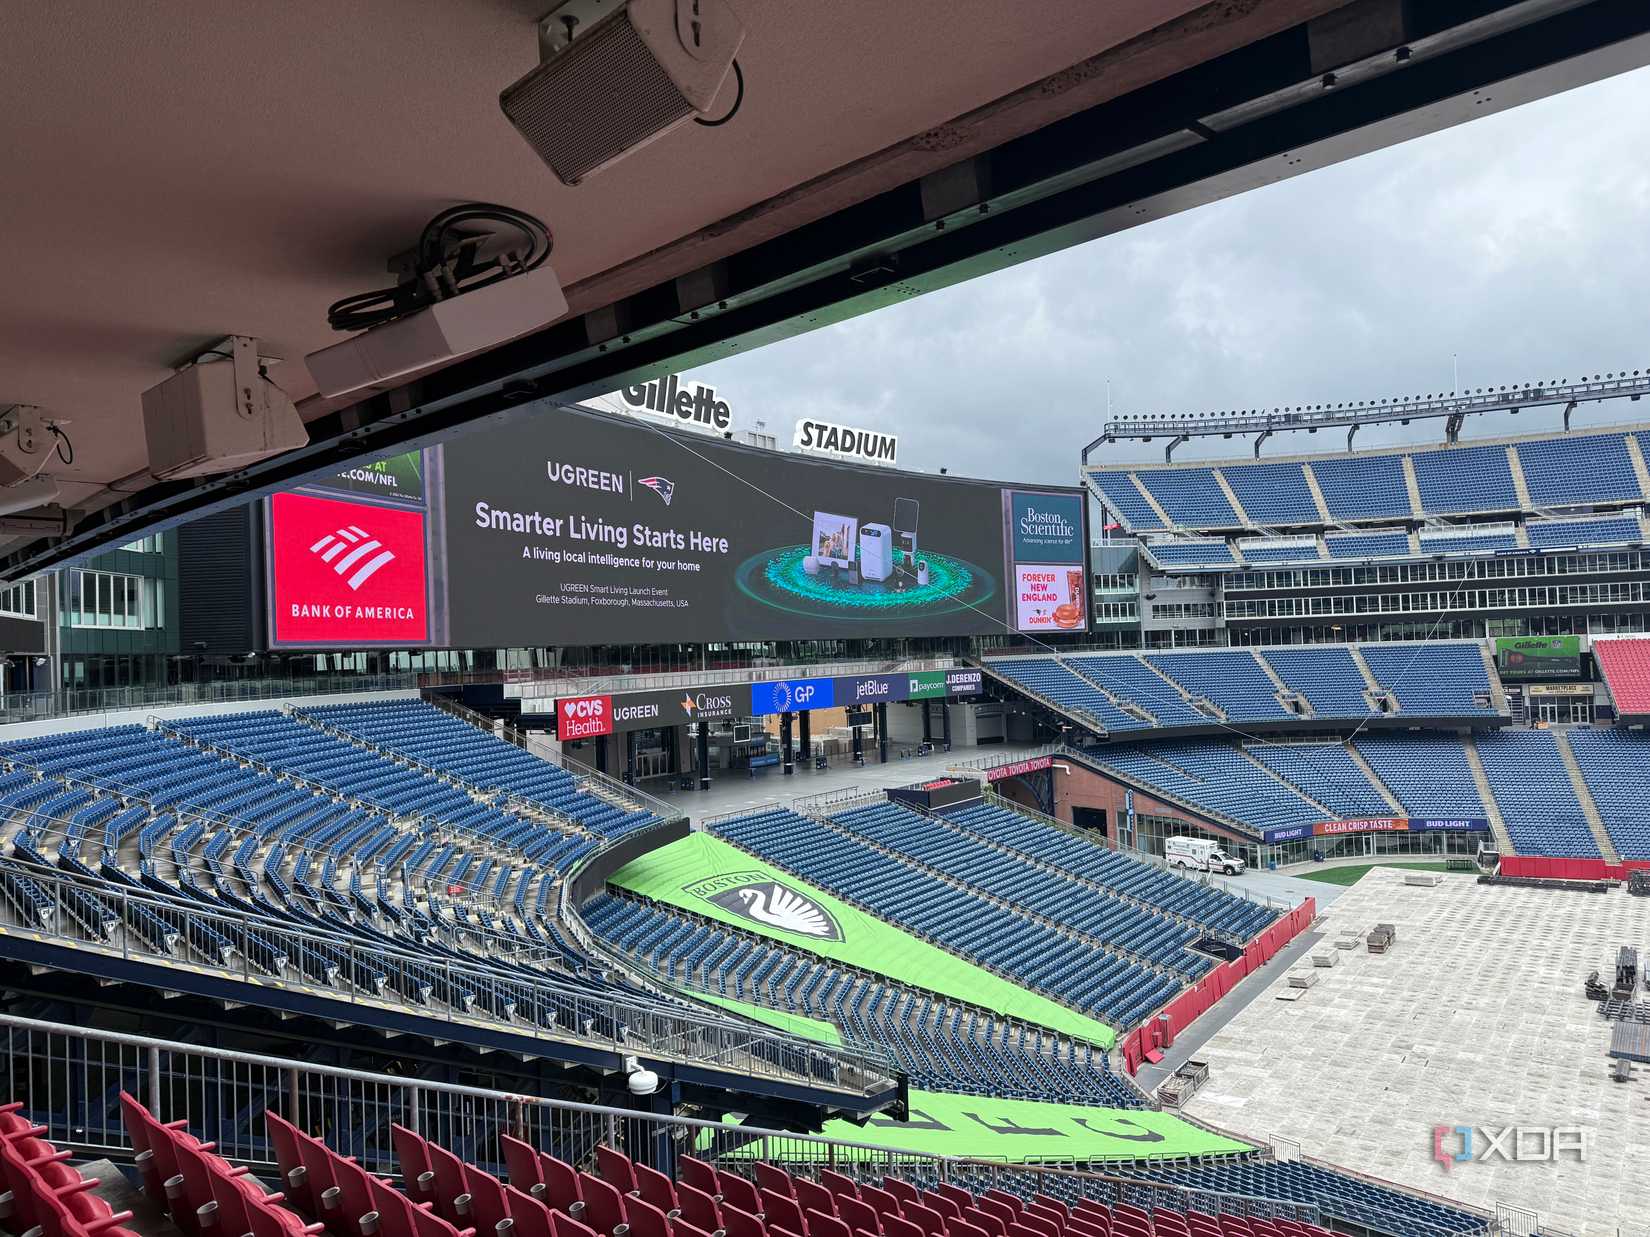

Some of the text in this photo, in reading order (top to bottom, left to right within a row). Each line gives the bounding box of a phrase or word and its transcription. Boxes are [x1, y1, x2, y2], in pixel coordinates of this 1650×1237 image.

[621, 375, 730, 428] Gillette
[801, 421, 896, 460] STADIUM
[547, 461, 624, 493] UGREEN
[1027, 507, 1061, 524] Boston
[475, 501, 729, 553] Smarter Living Starts Here
[1020, 517, 1074, 537] Scientific
[522, 545, 700, 572] A living local intelligence for your home
[1022, 573, 1056, 582] FOREVER
[560, 583, 668, 596] UGREEN Smart Living Launch Event
[1030, 583, 1048, 592] NEW
[535, 594, 689, 608] Gillette Stadium, Foxborough, Massachusetts, USA
[1021, 593, 1058, 602] ENGLAND
[291, 604, 415, 619] BANK OF AMERICA
[1514, 641, 1548, 649] Gillette
[856, 681, 889, 700] jetBlue
[576, 700, 603, 717] CVS
[613, 704, 659, 721] UGREEN
[697, 709, 732, 718] INSURANCE
[988, 757, 1052, 780] OYOTA TOYOTA TOYOTA
[1324, 819, 1393, 833] CLEAN CRISP TASTE
[1445, 820, 1471, 828] LIGHT
[1286, 829, 1302, 838] LIGHT
[692, 873, 768, 896] BOSTON
